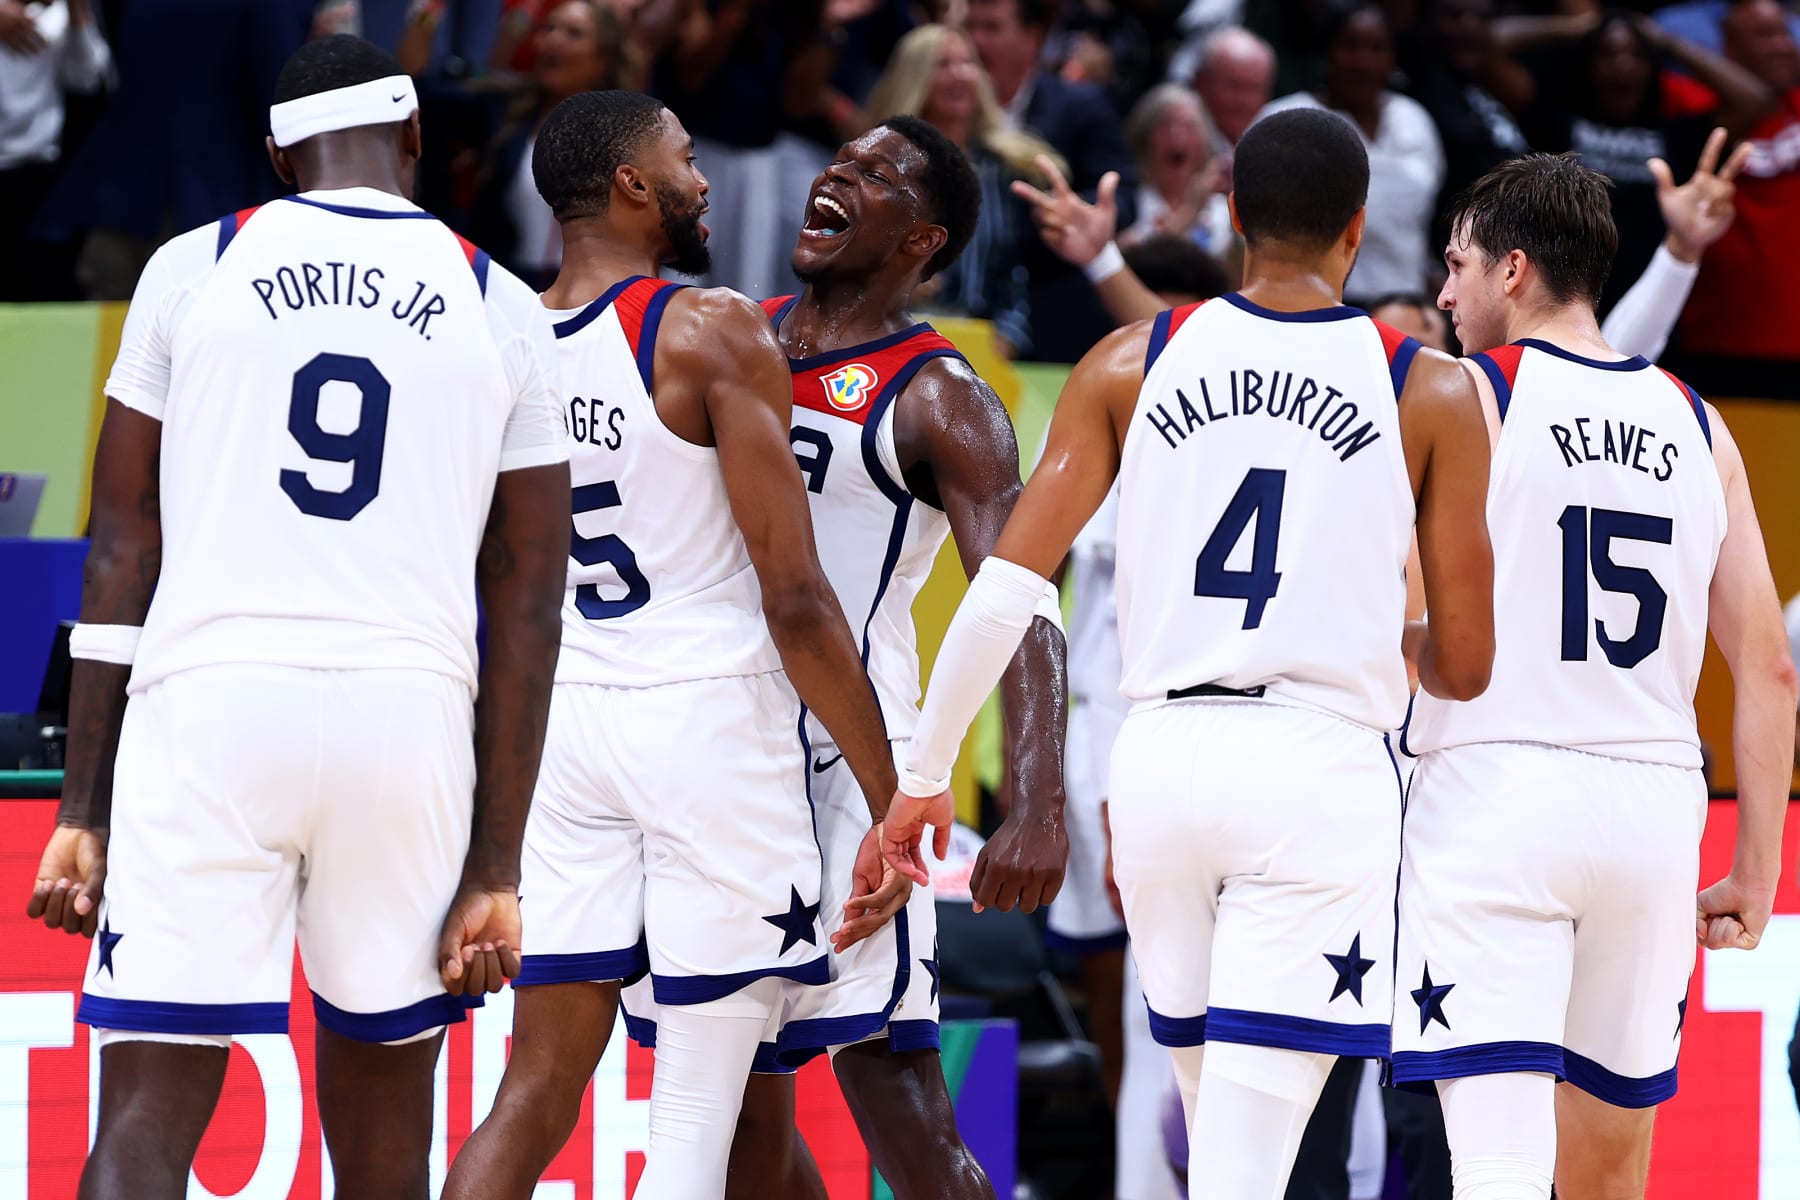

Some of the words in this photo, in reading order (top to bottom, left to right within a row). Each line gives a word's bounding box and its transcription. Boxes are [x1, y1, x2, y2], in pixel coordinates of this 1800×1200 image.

[251, 262, 385, 320] PORTIS
[391, 281, 446, 341] JR.
[279, 352, 392, 521] 9
[563, 396, 625, 451] GES
[1146, 369, 1381, 462] HALIBURTON
[1549, 417, 1679, 482] REAVES
[569, 480, 651, 620] 5
[1194, 467, 1287, 630] 4
[1556, 504, 1674, 669] 15
